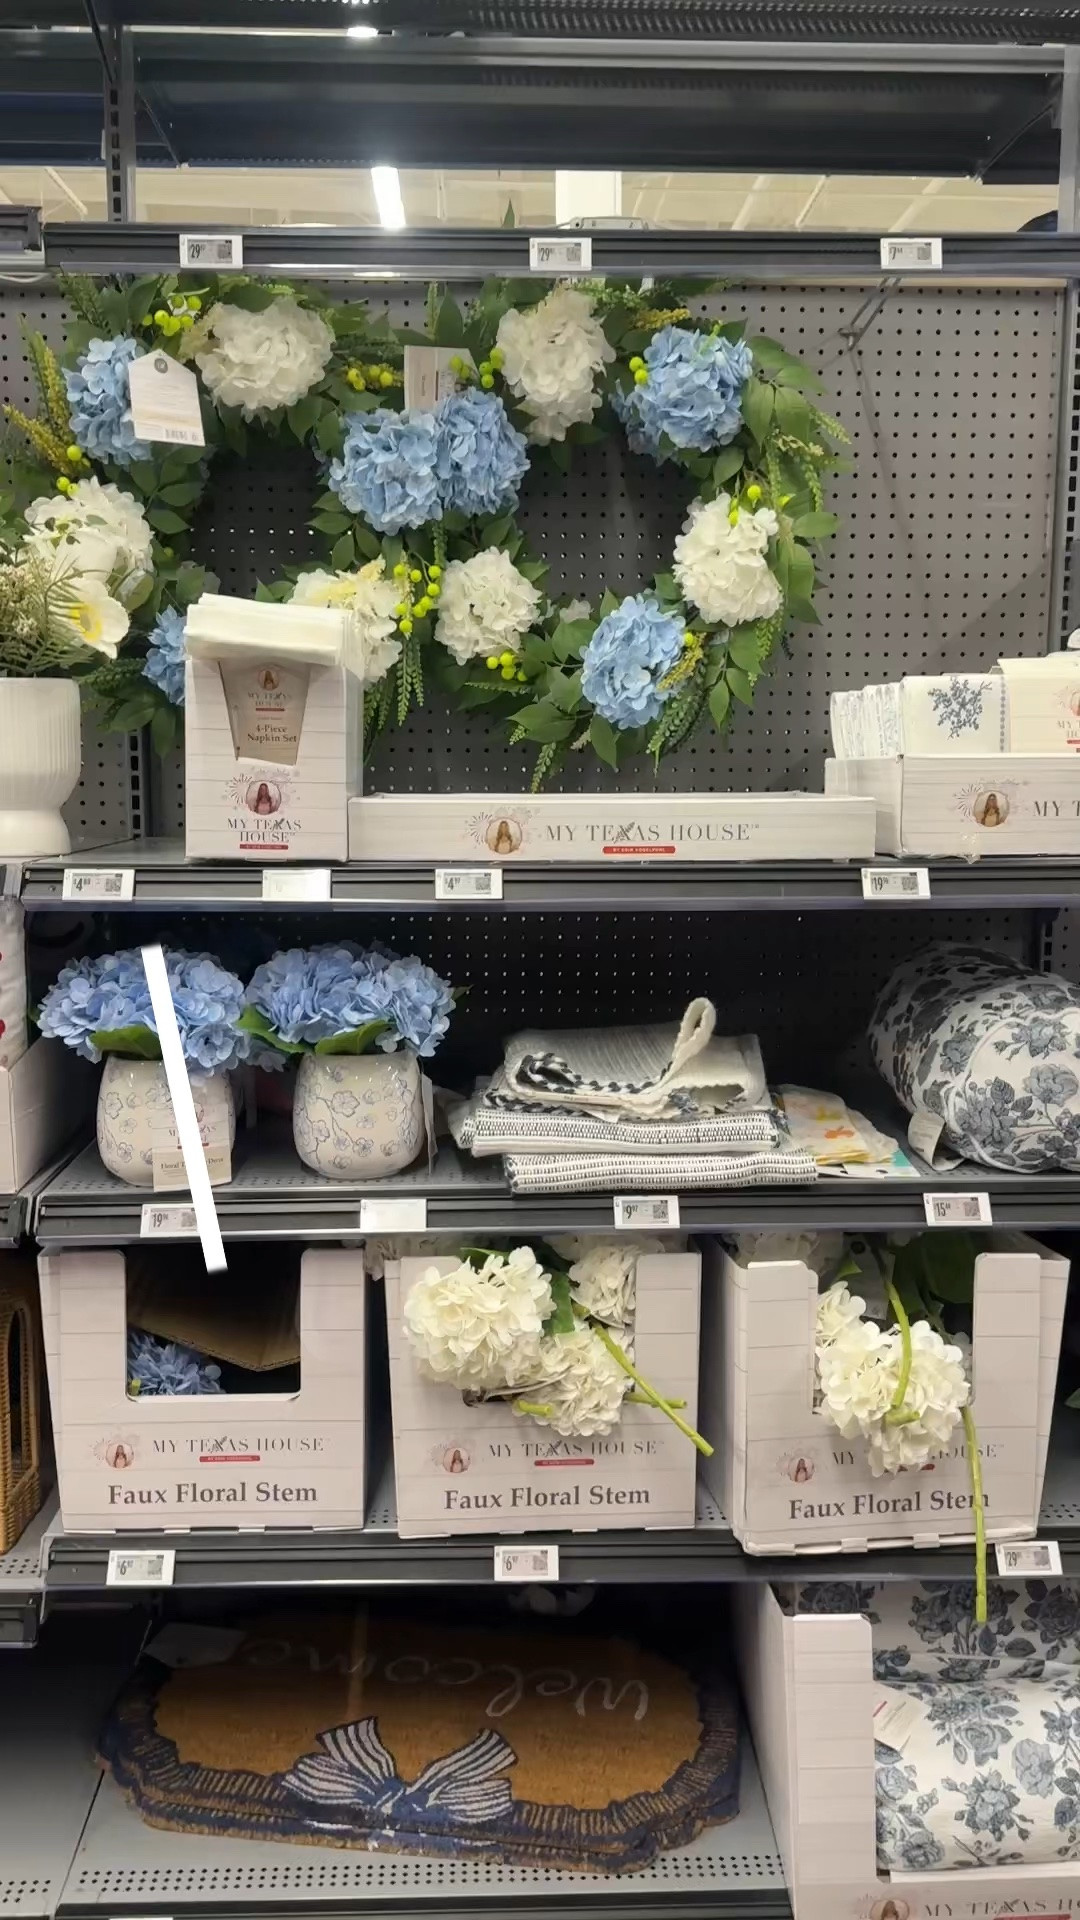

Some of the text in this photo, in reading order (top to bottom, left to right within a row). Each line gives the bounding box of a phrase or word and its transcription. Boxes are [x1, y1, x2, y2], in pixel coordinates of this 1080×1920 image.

[256, 723, 287, 733] 4-Piece
[247, 733, 297, 744] Napkin Set
[1032, 800, 1063, 817] MY
[227, 817, 302, 832] MY TEXAS
[545, 824, 576, 841] MY
[586, 821, 660, 844] TEXAS
[153, 1436, 325, 1454] MY TEXAS HOUSE
[489, 1444, 513, 1457] MY
[521, 1440, 584, 1458] TEXAS
[832, 1451, 856, 1465] MY
[108, 1481, 318, 1505] Faux Floral Stem
[444, 1485, 650, 1510] Faux Floral Stem
[789, 1499, 846, 1520] Faux
[852, 1491, 922, 1516] Floral
[925, 1904, 953, 1917] MY
[966, 1898, 1047, 1917] TEXAS
